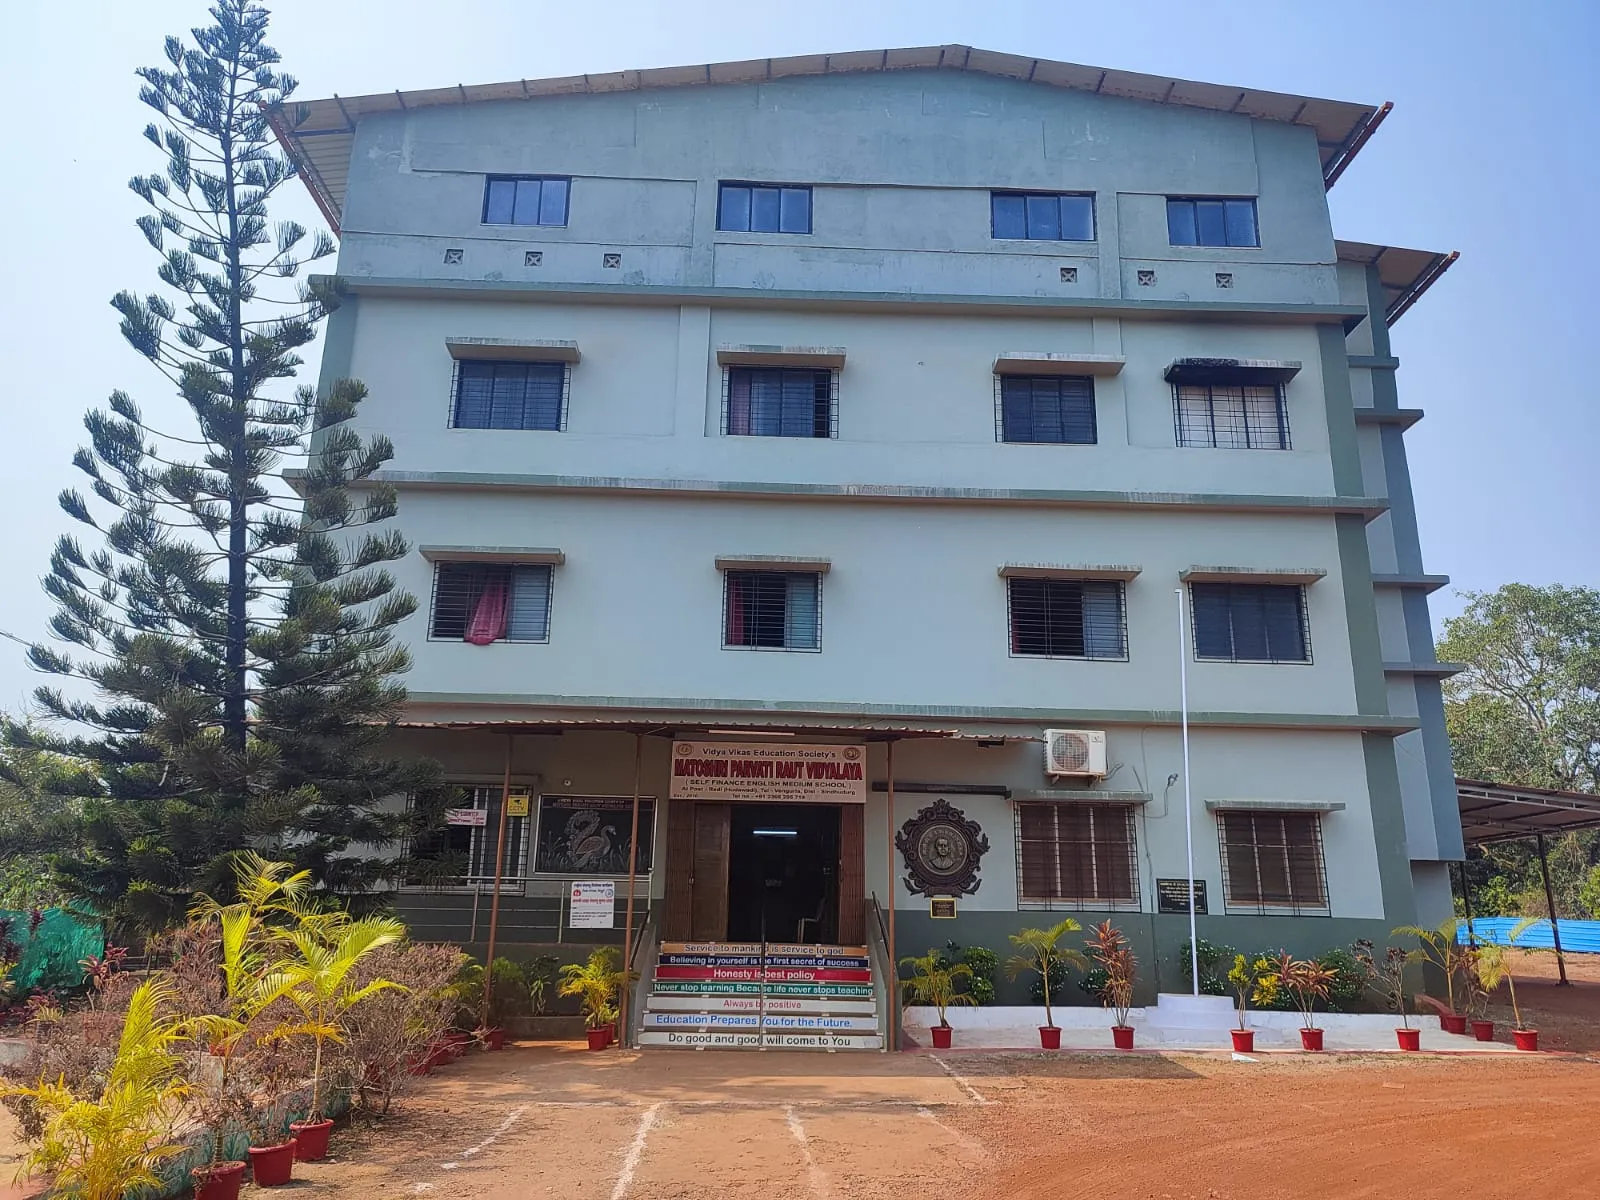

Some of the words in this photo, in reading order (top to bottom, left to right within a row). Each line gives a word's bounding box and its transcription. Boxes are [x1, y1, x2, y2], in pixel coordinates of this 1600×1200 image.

[703, 748, 726, 757] Vidya
[729, 748, 750, 756] Vikas
[753, 749, 796, 757] Education
[799, 750, 836, 759] Society's
[775, 761, 805, 778] RAUT
[806, 762, 863, 780] VIDYALAYA
[684, 944, 718, 952] Service
[781, 946, 814, 954] service
[816, 946, 825, 954] to
[827, 946, 844, 956] god
[670, 955, 706, 965] Believing
[707, 956, 715, 964] in
[716, 957, 748, 966] yourself
[750, 957, 758, 965] is
[759, 957, 772, 965] te
[773, 957, 790, 965] first
[790, 958, 817, 966] secret
[818, 957, 826, 965] of
[826, 959, 859, 967] success
[713, 969, 752, 980] Honesty
[764, 970, 786, 979] best
[787, 970, 815, 981] policy
[654, 983, 679, 991] Never
[680, 984, 699, 992] stop
[700, 984, 734, 993] learning
[736, 984, 772, 993] Because
[773, 985, 786, 993] life
[788, 986, 811, 994] never
[813, 986, 836, 995] stops
[838, 987, 873, 996] teaching
[723, 1000, 753, 1009] Always
[768, 1001, 801, 1010] positive
[656, 1014, 708, 1024] Education
[710, 1015, 757, 1026] Prepares
[761, 1016, 779, 1025] You
[781, 1016, 794, 1026] for
[798, 1016, 814, 1027] the
[817, 1017, 853, 1028] Future.
[668, 1033, 682, 1043] Do
[685, 1033, 711, 1045] good
[714, 1034, 732, 1043] and
[737, 1035, 763, 1045] good
[766, 1035, 783, 1045] will
[786, 1037, 815, 1045] come
[818, 1037, 829, 1045] to
[831, 1036, 851, 1046] You
